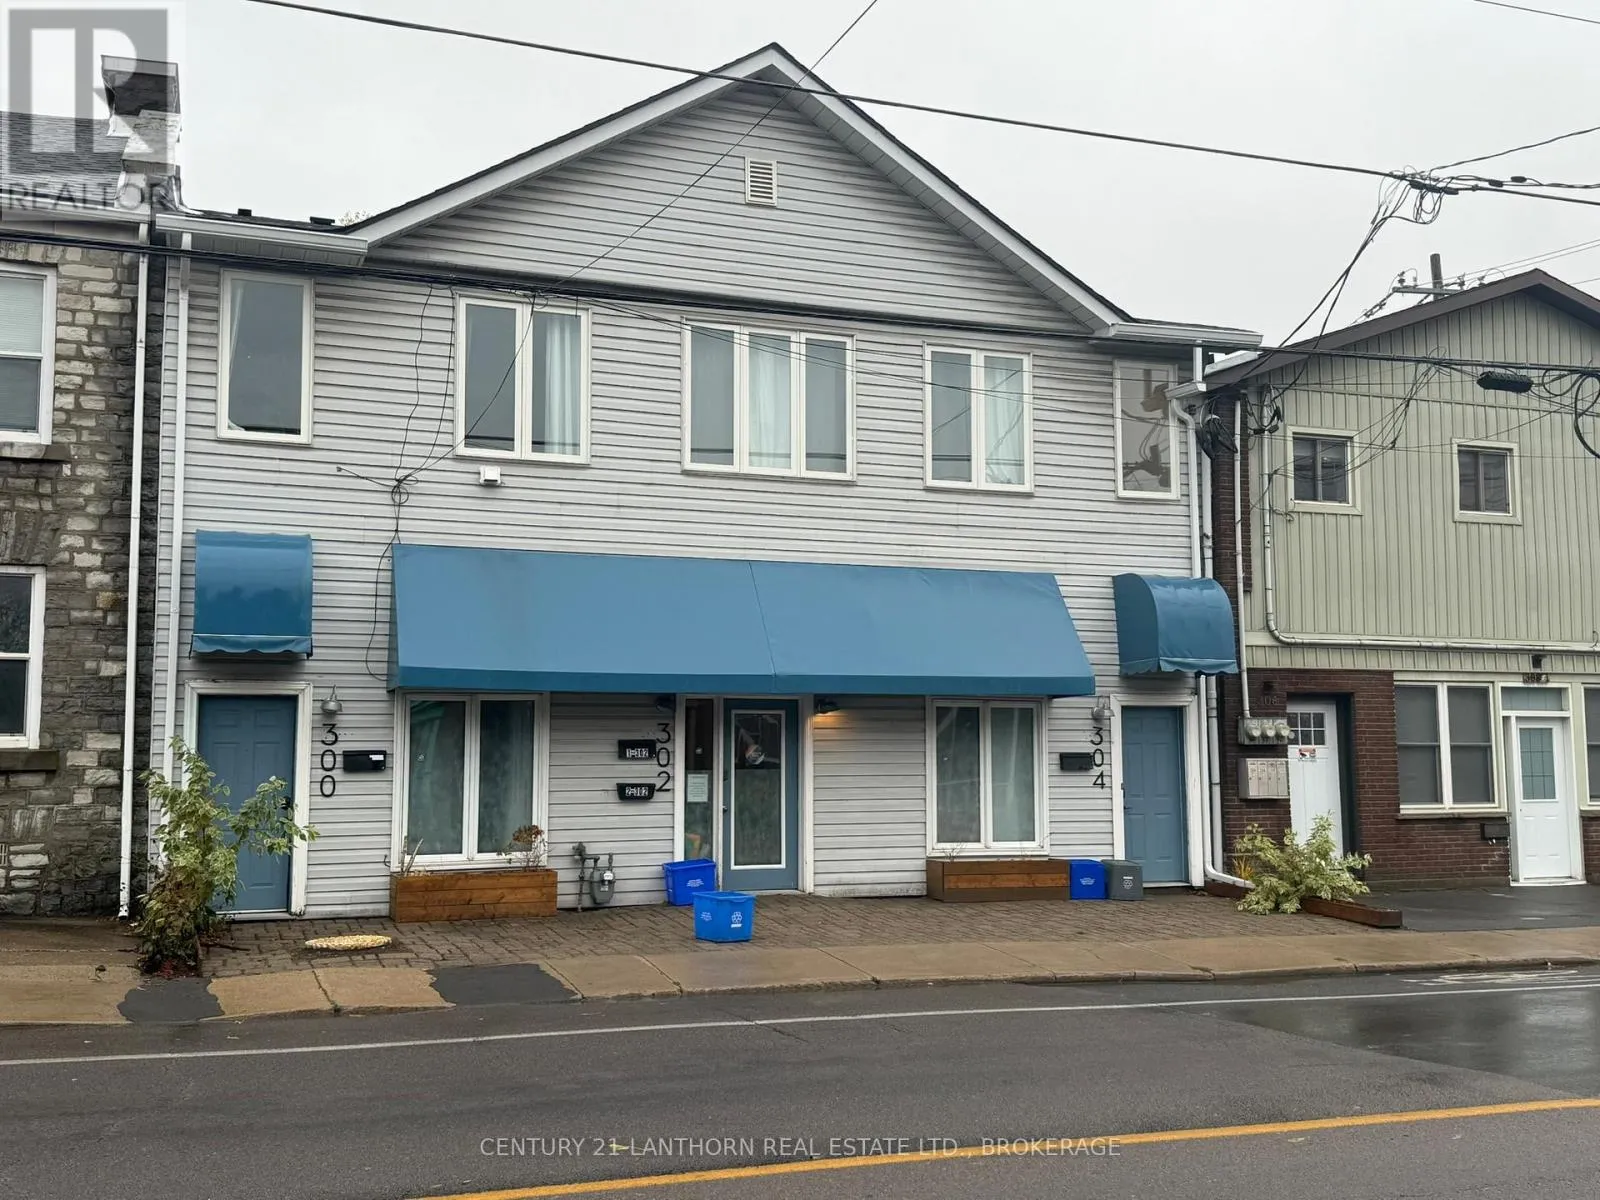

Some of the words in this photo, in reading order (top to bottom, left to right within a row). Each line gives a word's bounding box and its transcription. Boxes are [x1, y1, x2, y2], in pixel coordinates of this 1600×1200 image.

[320, 723, 339, 798] 300
[655, 722, 671, 792] 302
[1089, 726, 1106, 790] 304
